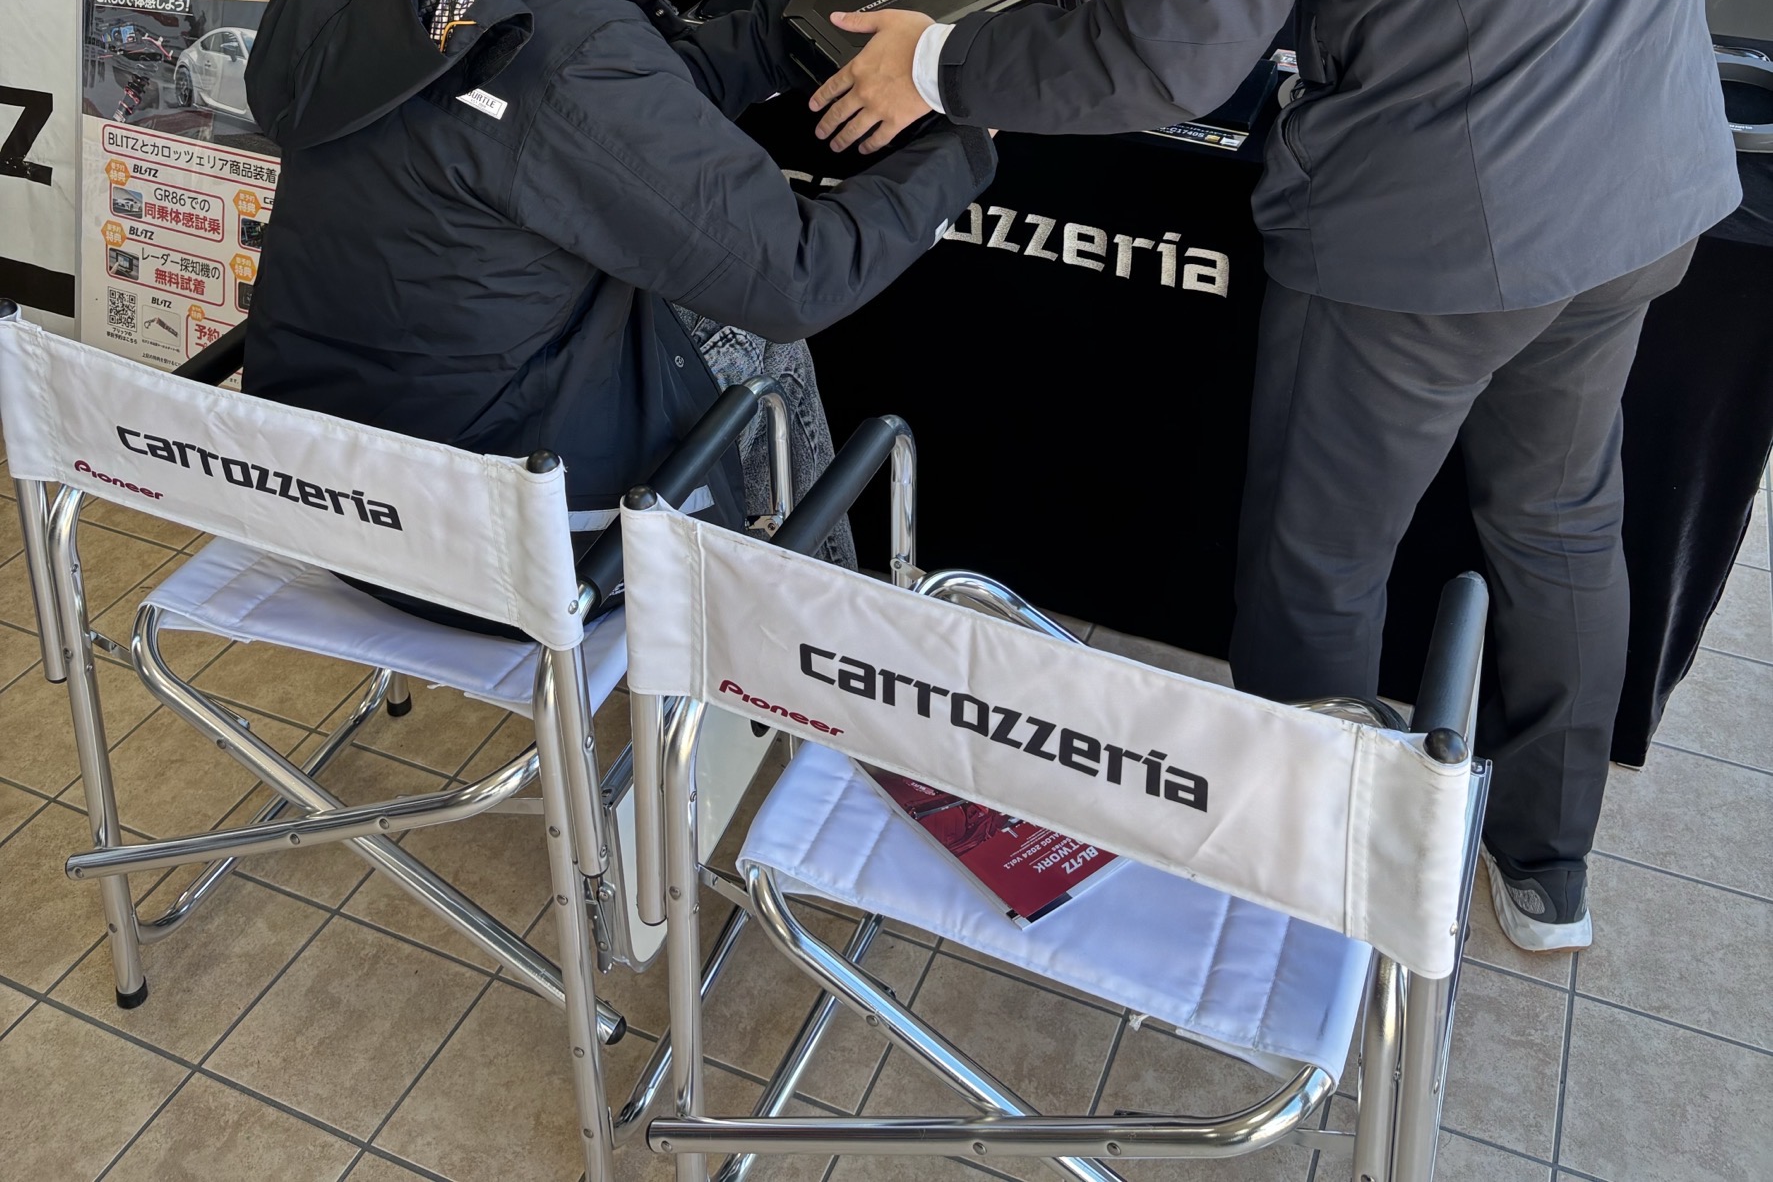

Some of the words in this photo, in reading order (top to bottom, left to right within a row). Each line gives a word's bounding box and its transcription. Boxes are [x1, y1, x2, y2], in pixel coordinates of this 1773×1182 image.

[108, 132, 277, 184] BLITZとカロッツェリア商品装着
[133, 164, 159, 178] BLITZ
[154, 187, 211, 213] GR86での
[129, 226, 154, 240] BLITZ
[144, 202, 221, 236] 同乗体感試乗
[106, 232, 122, 244] 特典
[141, 247, 220, 280] レーダー探知機の
[154, 268, 206, 296] 無料試着
[152, 296, 172, 308] BLITZ
[74, 460, 164, 500] Pioneer
[116, 425, 403, 532] carrozzeria
[718, 679, 844, 736] Pioneer
[800, 643, 1208, 813] carrozzeria
[1061, 846, 1099, 874] BLITZ
